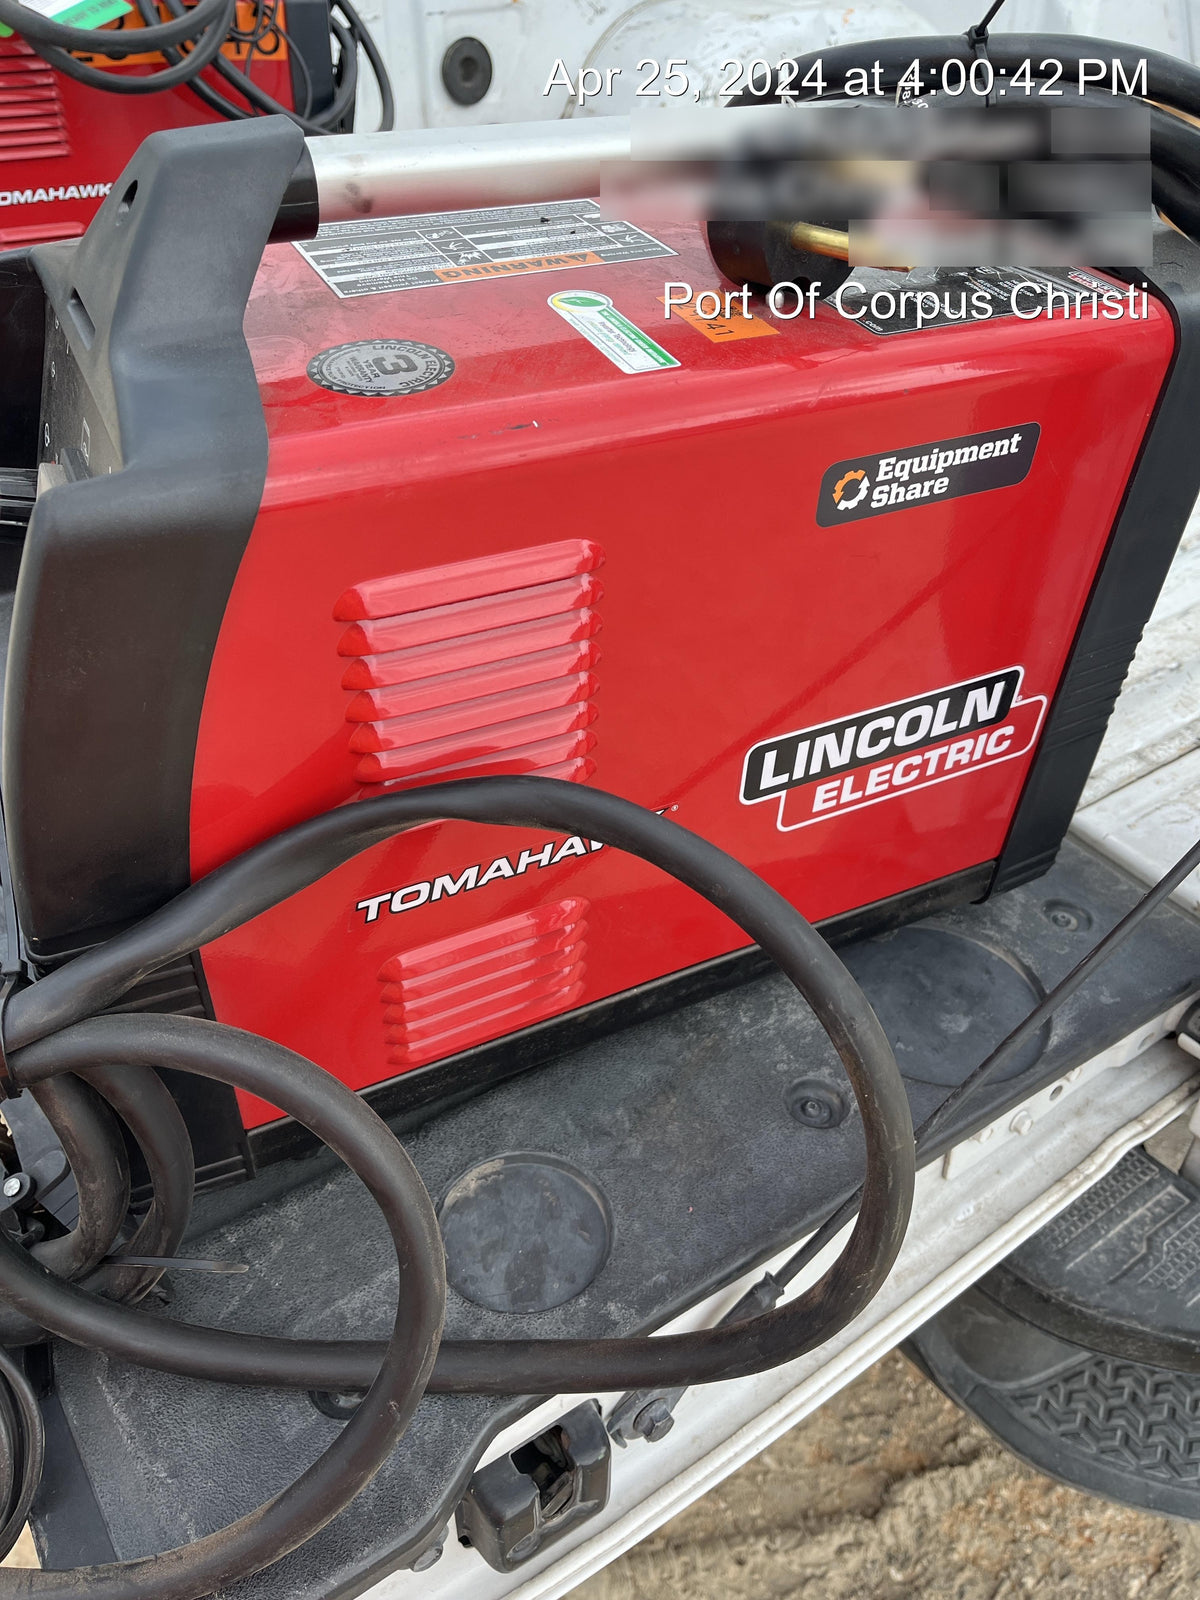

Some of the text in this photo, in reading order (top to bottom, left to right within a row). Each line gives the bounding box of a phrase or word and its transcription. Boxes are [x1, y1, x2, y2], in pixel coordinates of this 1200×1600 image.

[442, 256, 569, 279] WARNING
[349, 356, 373, 383] WARRANTY
[363, 359, 381, 379] YEAR
[371, 354, 419, 376] 3
[372, 344, 438, 388] LINCOLN ELECTRIC
[875, 432, 1022, 482] Equipment
[870, 476, 950, 509] Share
[759, 681, 1006, 791] LINCOLN
[812, 725, 1015, 813] ELECTRIC
[356, 807, 669, 923] TOMAHA
